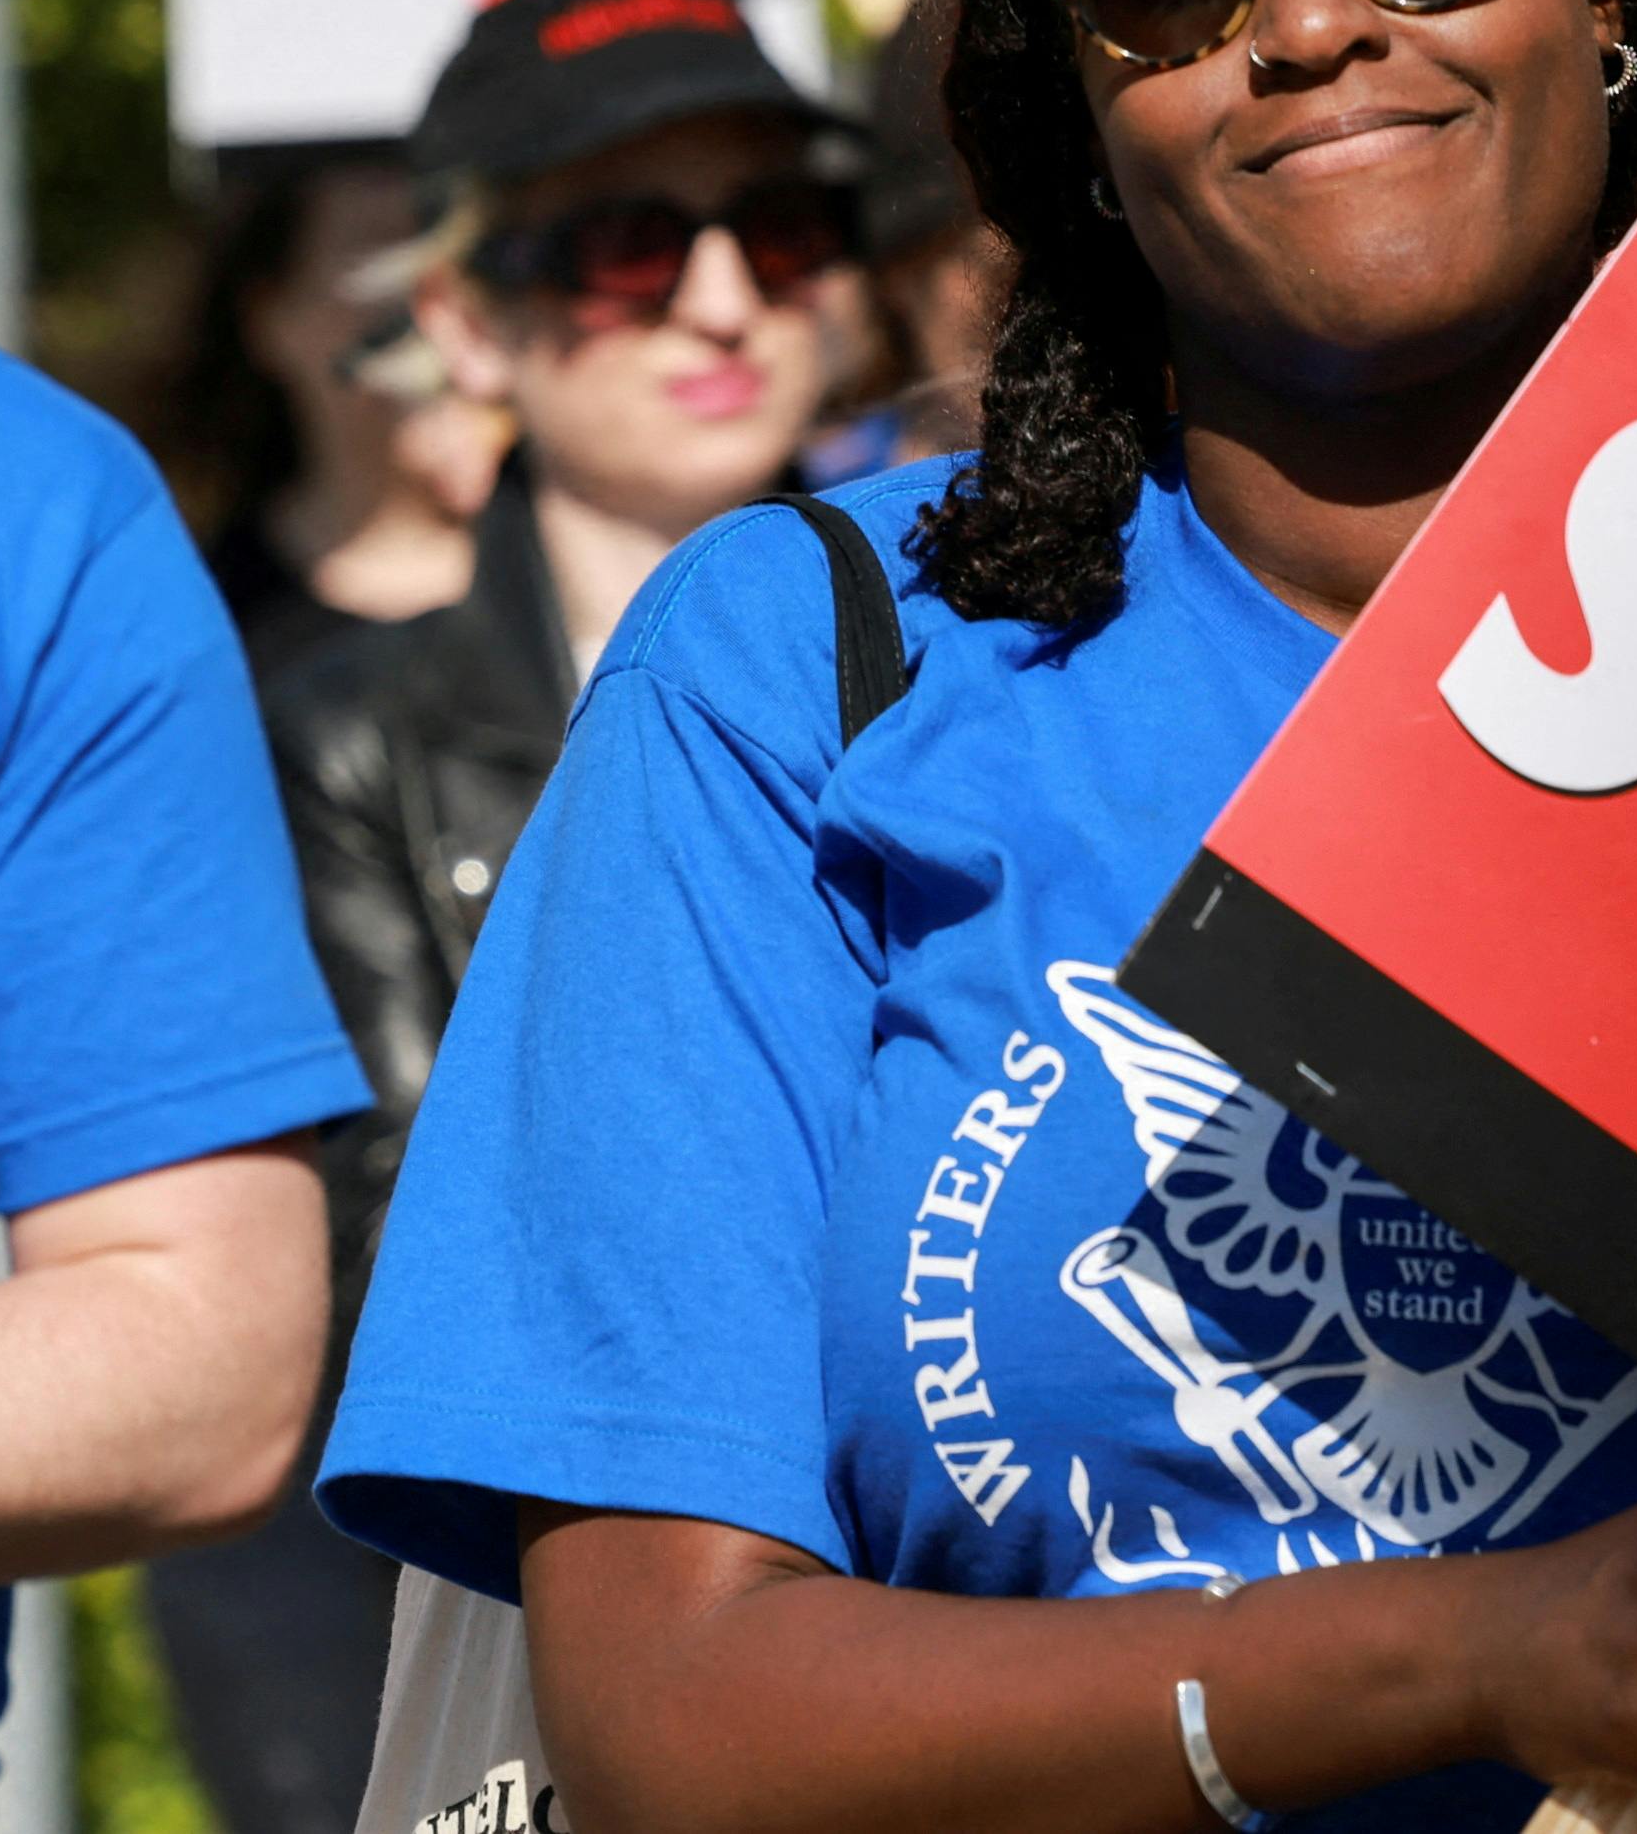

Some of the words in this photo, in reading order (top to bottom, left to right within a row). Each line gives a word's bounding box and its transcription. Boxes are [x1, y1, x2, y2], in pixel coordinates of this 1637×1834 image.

[1359, 1210, 1485, 1254] unite
[900, 1029, 1066, 1528] WRITERS
[1396, 1257, 1457, 1289] we
[1364, 1285, 1484, 1326] stand
